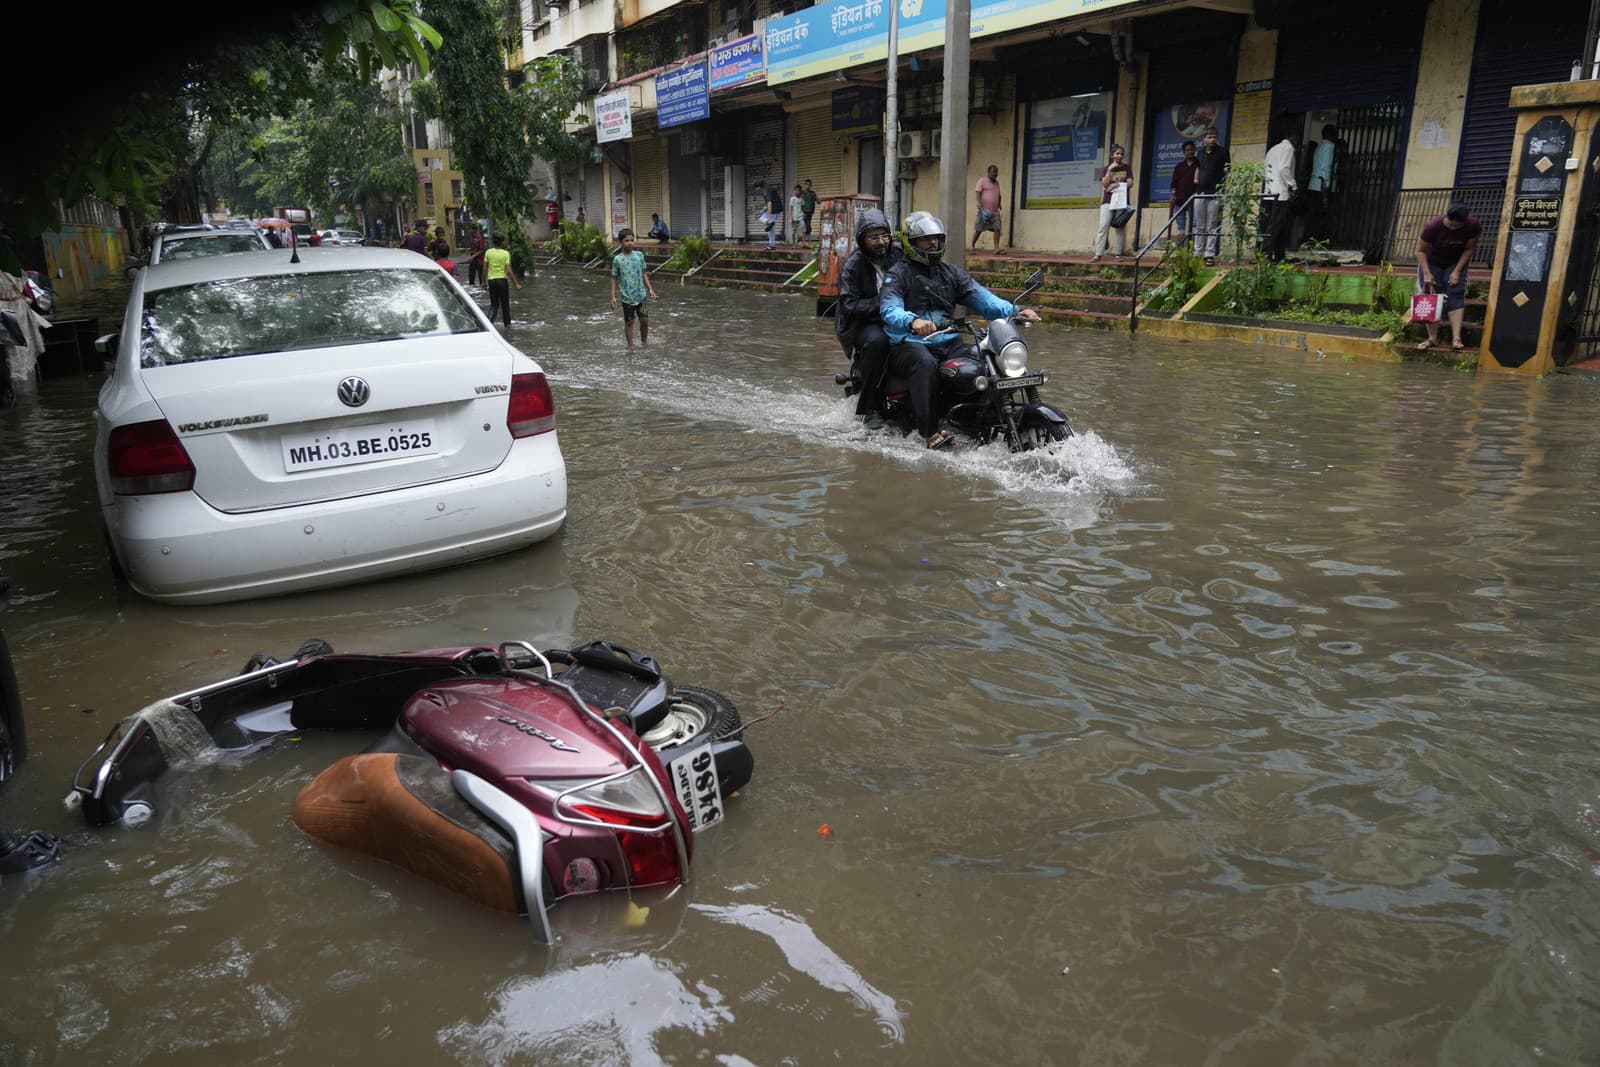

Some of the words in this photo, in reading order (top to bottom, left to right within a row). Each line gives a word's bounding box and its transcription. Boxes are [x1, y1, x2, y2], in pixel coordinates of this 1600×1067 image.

[831, 5, 864, 33] इंडियन
[766, 27, 793, 52] इंडियन
[474, 383, 508, 396] VENTO
[177, 413, 269, 434] VOLKSWAGEN
[289, 431, 433, 465] MH.03.BE.0525
